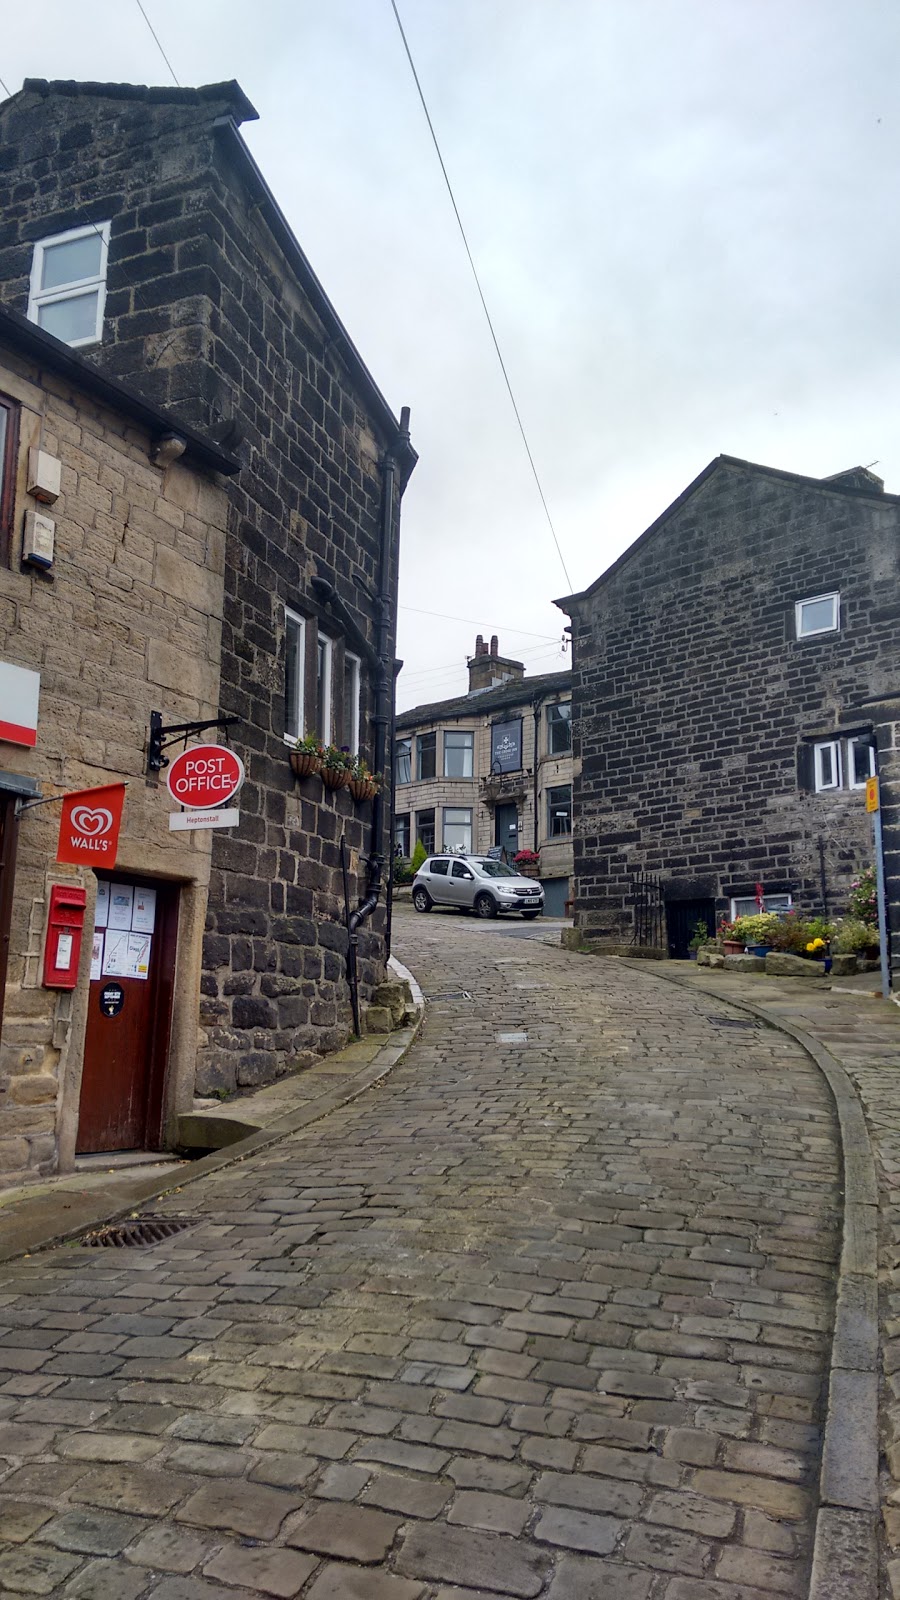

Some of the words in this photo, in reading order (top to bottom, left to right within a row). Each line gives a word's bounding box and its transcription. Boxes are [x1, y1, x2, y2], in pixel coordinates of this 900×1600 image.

[185, 757, 226, 776] POST
[175, 774, 231, 793] OFFICE
[186, 815, 219, 824] Heptonstall
[70, 836, 108, 852] WALL'S
